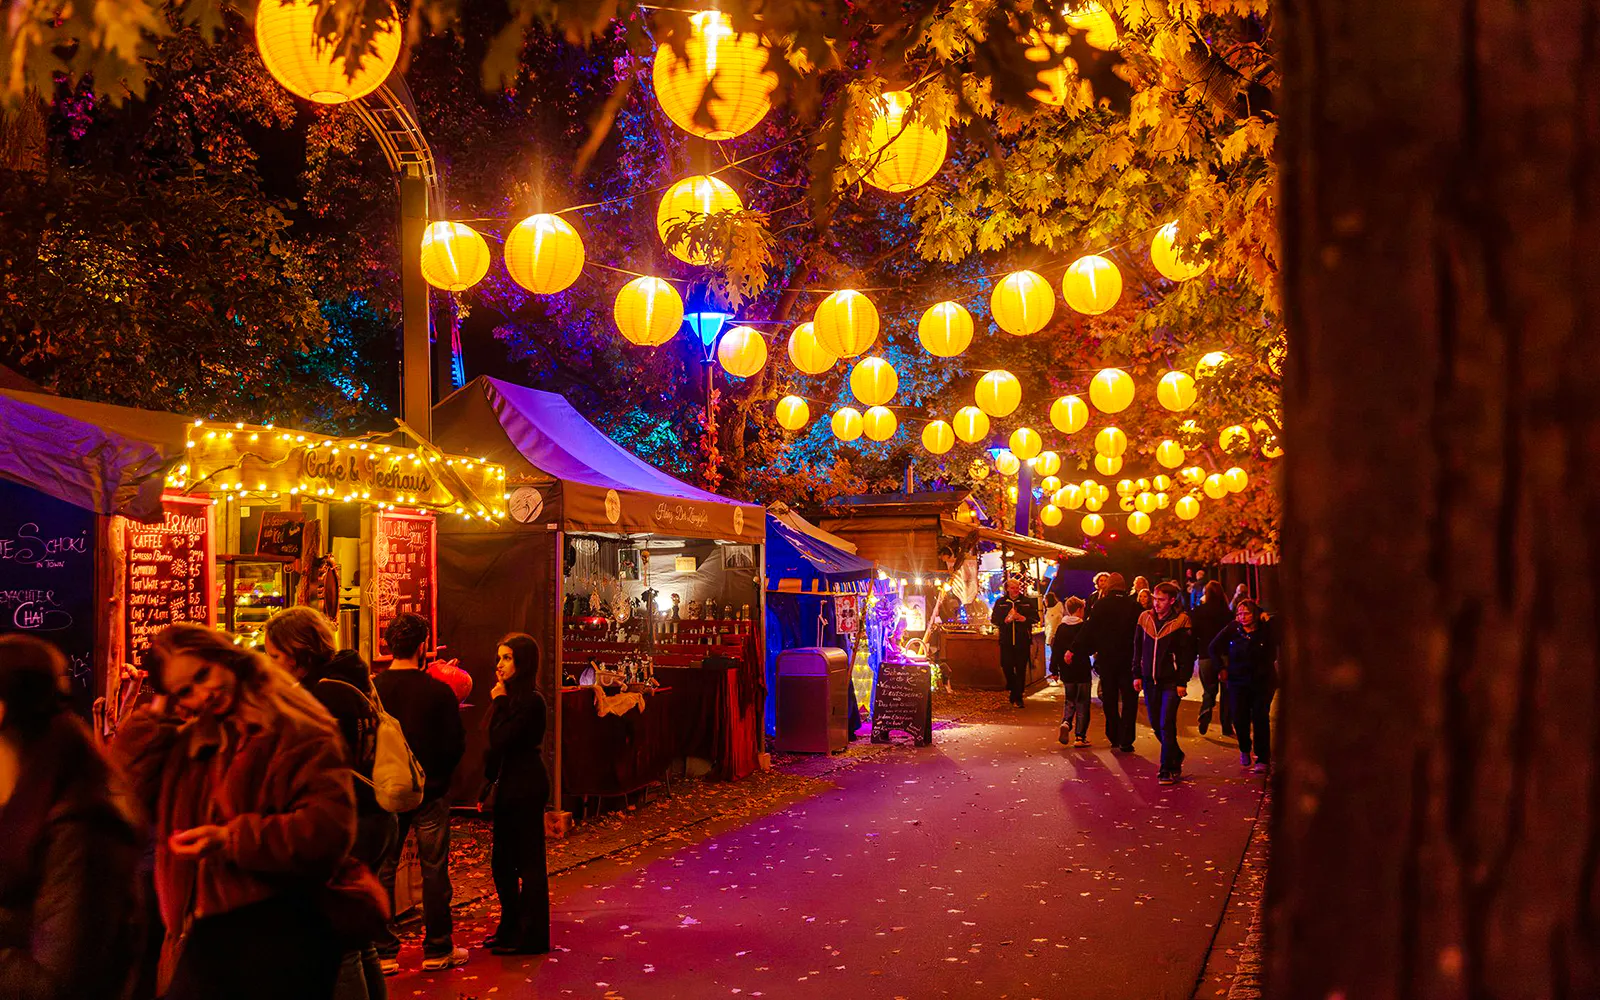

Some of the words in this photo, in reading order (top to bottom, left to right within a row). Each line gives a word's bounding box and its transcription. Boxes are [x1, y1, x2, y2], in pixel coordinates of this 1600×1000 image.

[306, 450, 347, 488] Cafe
[350, 456, 360, 481] &
[365, 457, 430, 492] Teehaus
[133, 533, 163, 549] KAFFEE
